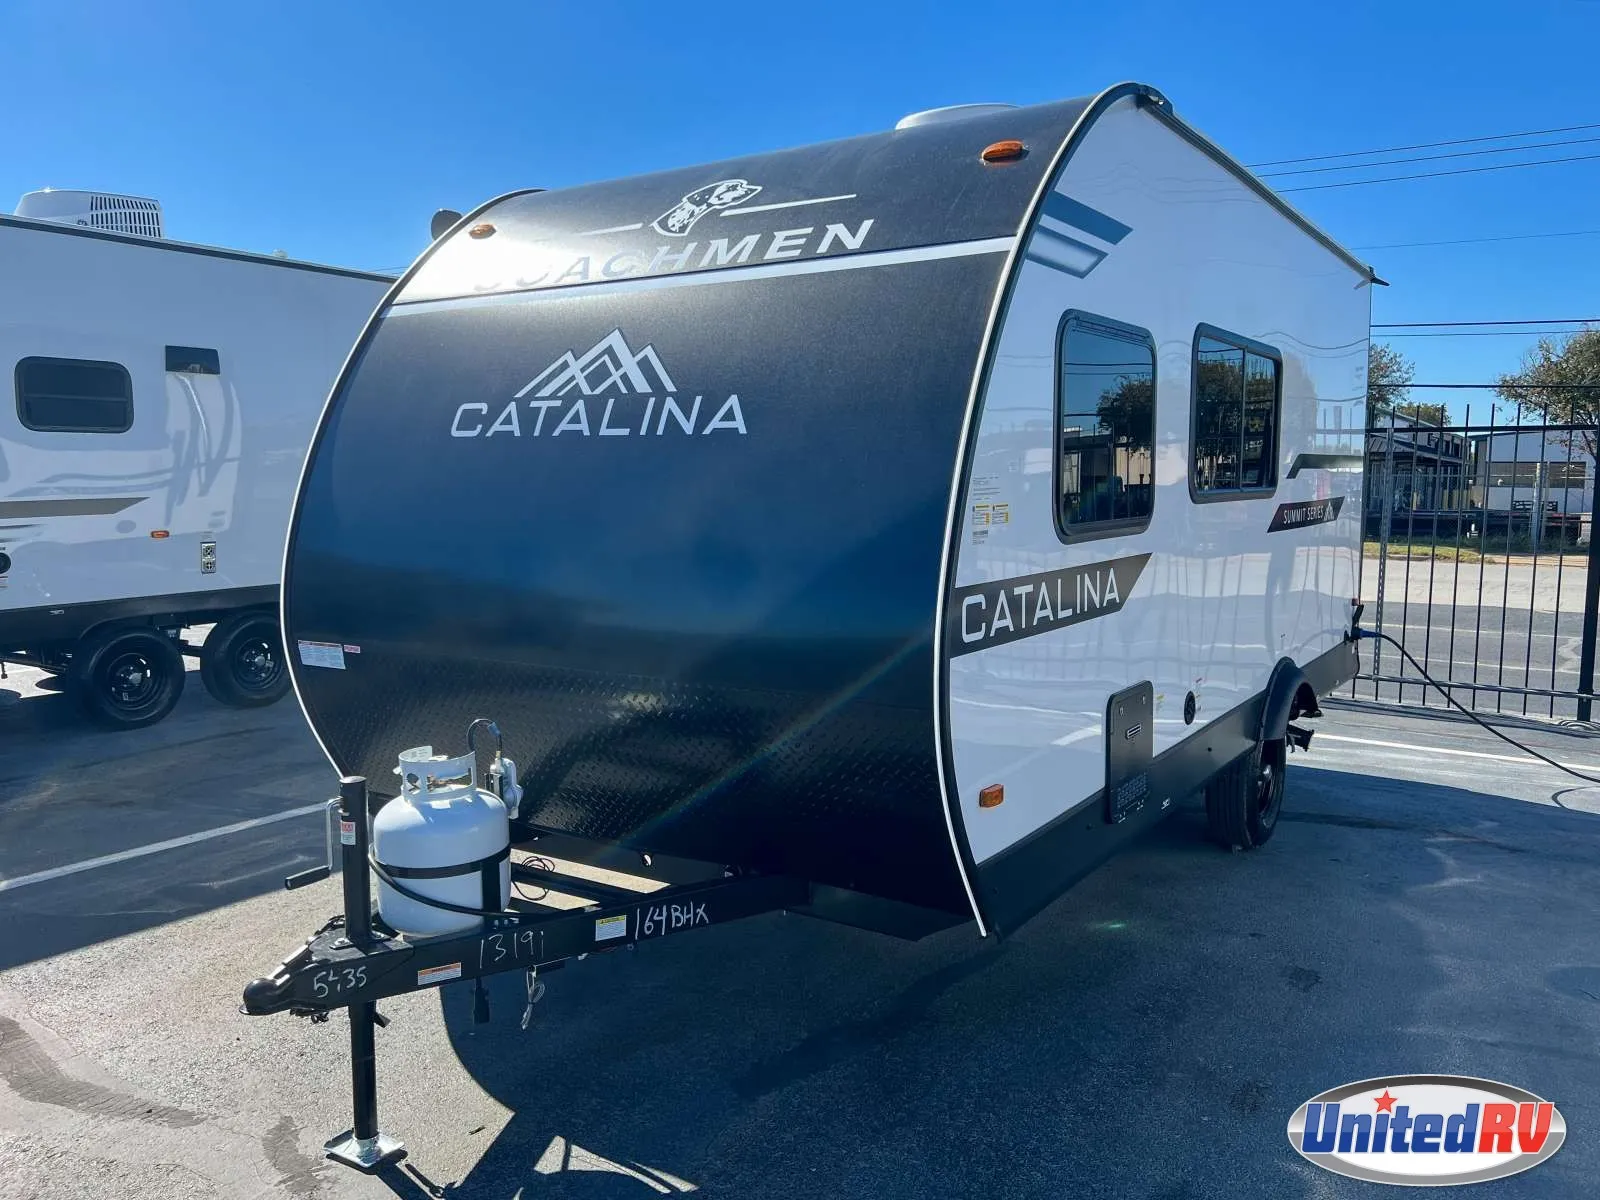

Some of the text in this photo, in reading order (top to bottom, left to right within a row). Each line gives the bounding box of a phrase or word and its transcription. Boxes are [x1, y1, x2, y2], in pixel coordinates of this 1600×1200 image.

[474, 218, 875, 293] ACHMEN
[450, 394, 747, 438] CATALINA
[1283, 504, 1324, 525] SUMMIT SERIES
[961, 567, 1121, 644] CATALINA
[635, 901, 709, 941] 164BHX
